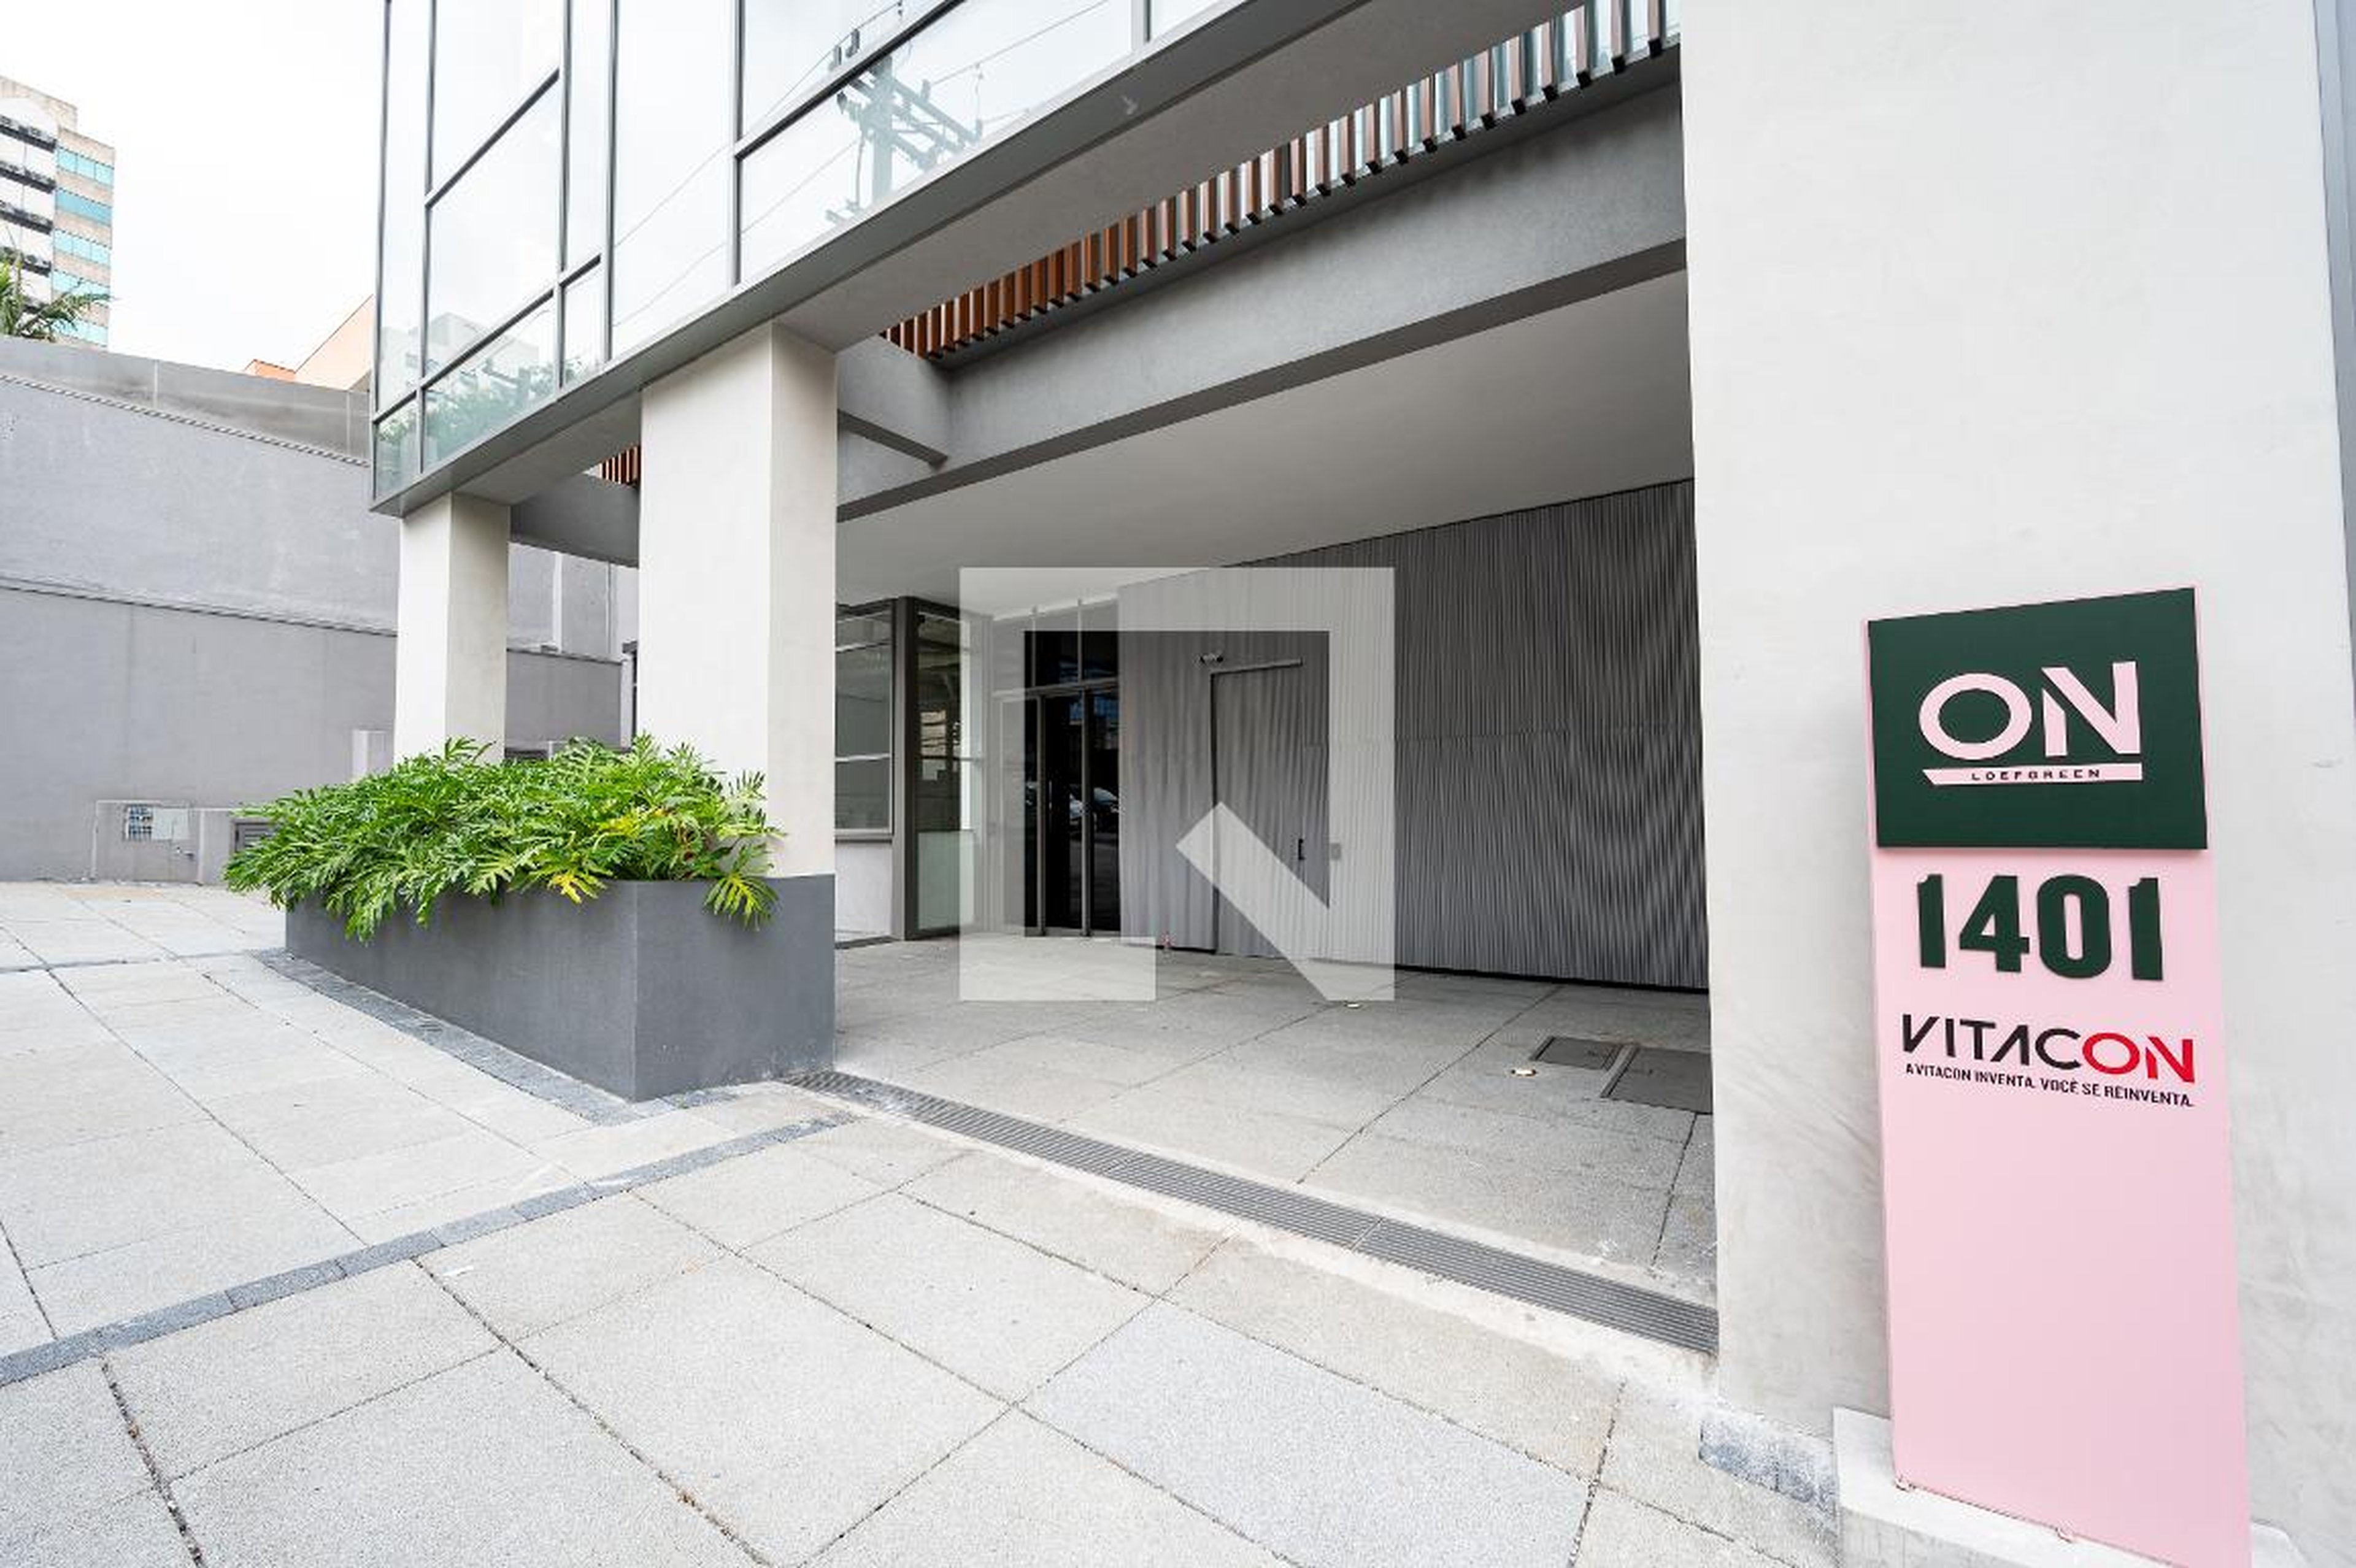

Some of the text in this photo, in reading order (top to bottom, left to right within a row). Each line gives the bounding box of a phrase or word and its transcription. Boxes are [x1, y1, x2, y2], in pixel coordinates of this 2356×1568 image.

[1919, 661, 2141, 760] ON
[1917, 874, 2163, 982] 1401
[1902, 1013, 2195, 1084] VITACON
[1975, 1071, 2036, 1089] INVENTA.
[2082, 1083, 2101, 1096] SE
[2104, 1085, 2195, 1107] REINVENTA.
